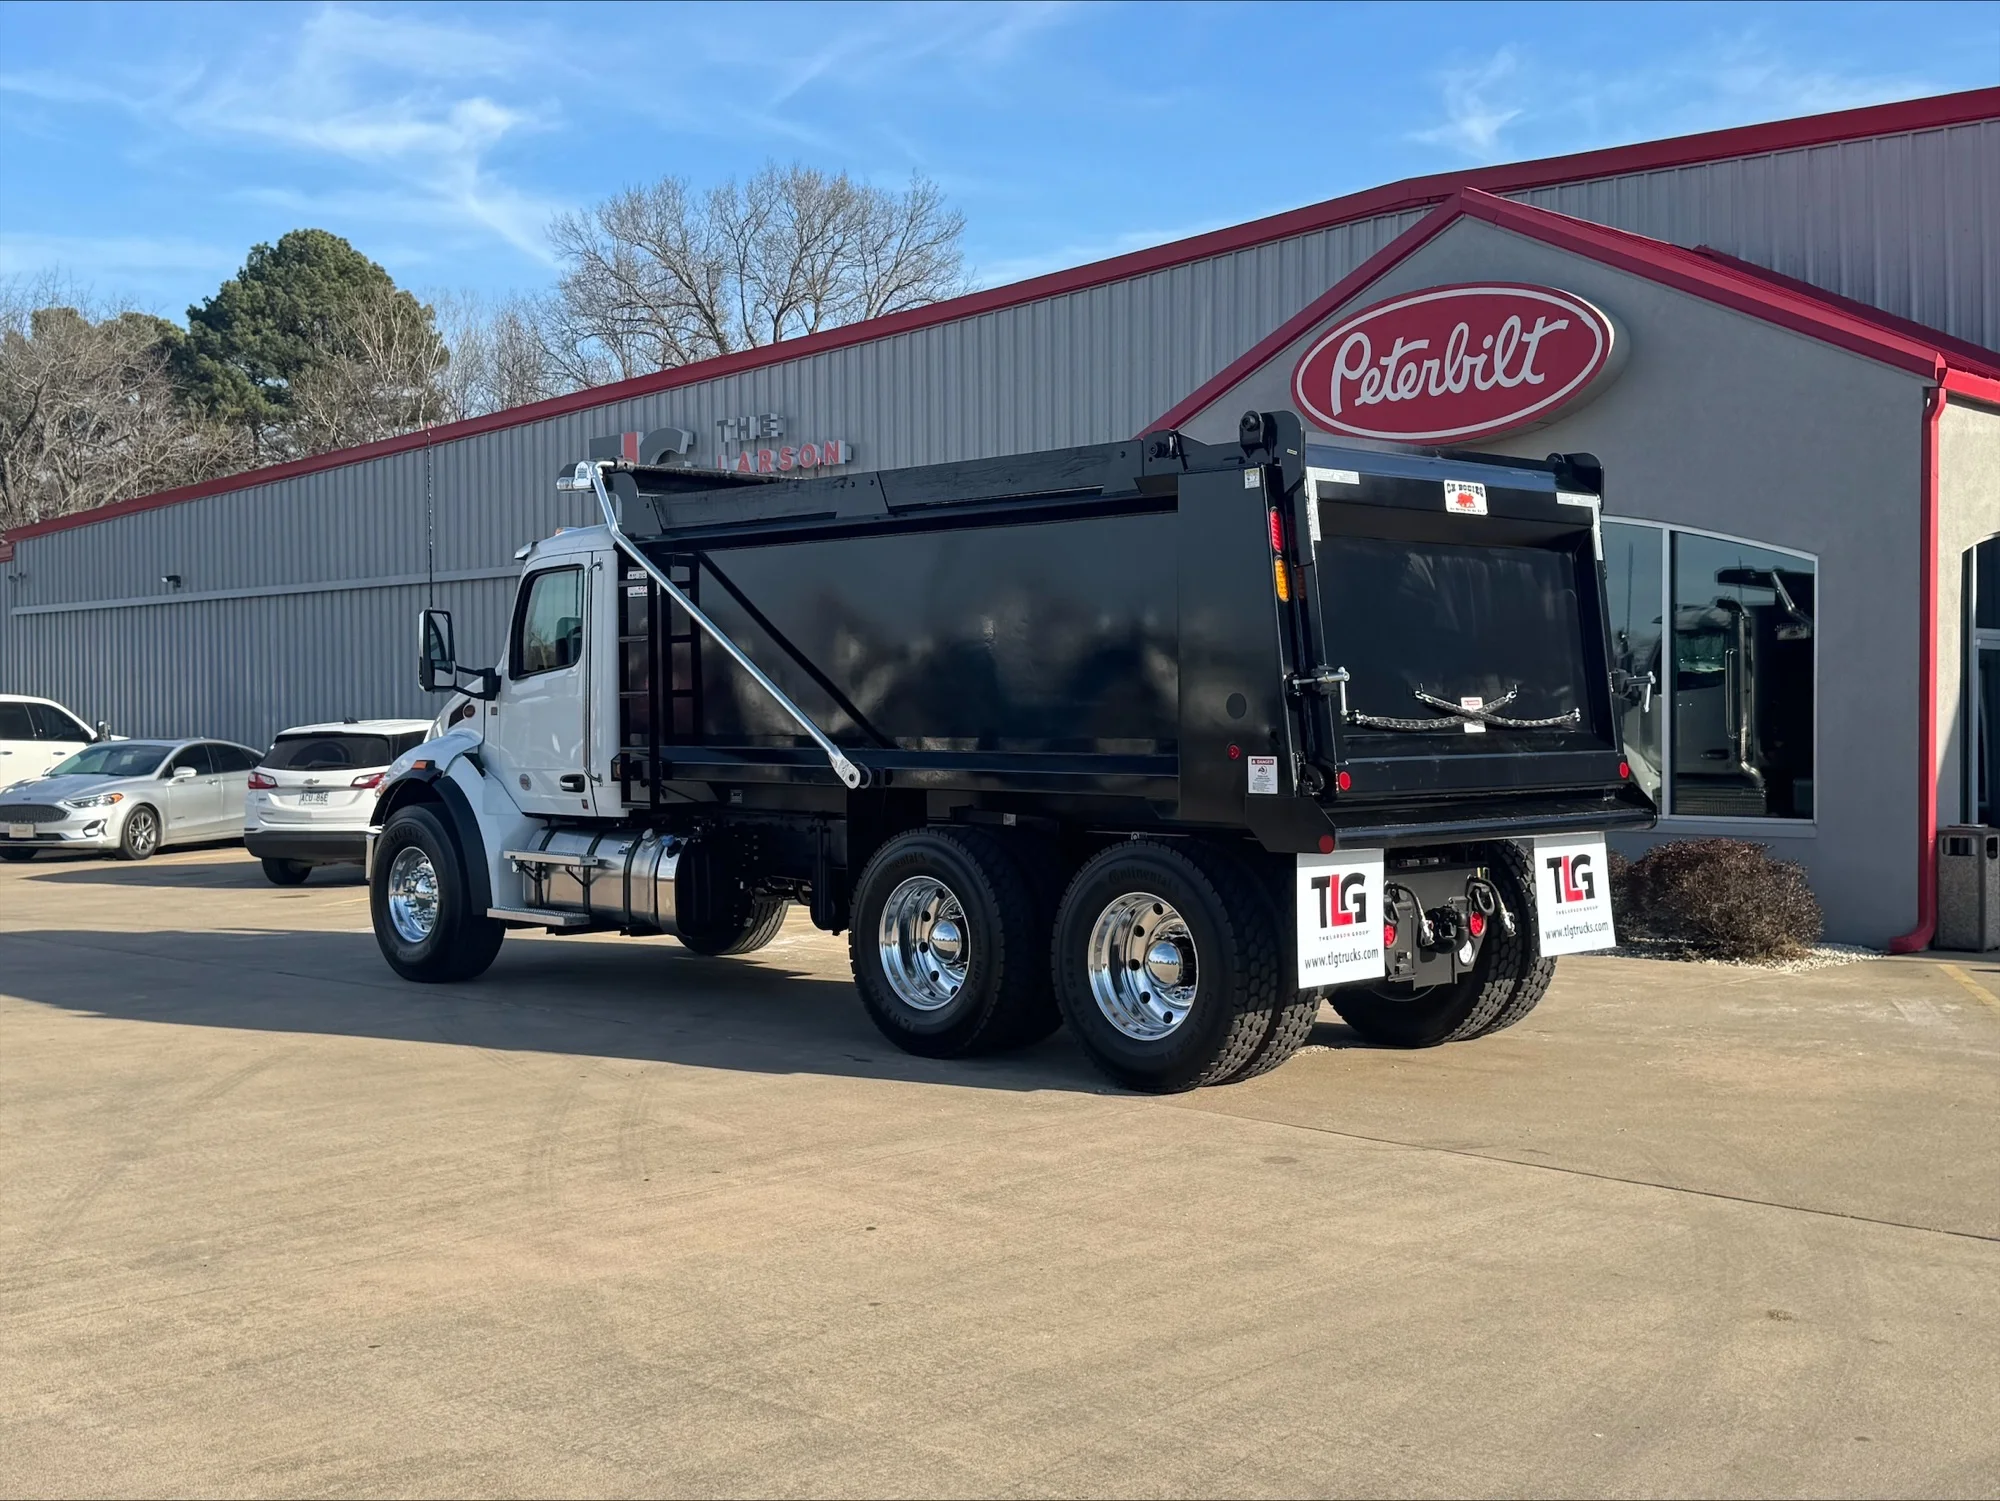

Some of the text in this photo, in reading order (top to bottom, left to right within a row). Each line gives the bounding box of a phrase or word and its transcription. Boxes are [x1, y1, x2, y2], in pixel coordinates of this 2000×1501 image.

[1330, 314, 1569, 416] Peterbilt
[716, 413, 777, 443] THE
[1546, 854, 1596, 904] TLG
[1311, 872, 1367, 929] TLG
[1545, 921, 1609, 940] www.tlgtrucks.com
[1304, 948, 1379, 969] www.tlgtrucks.com
